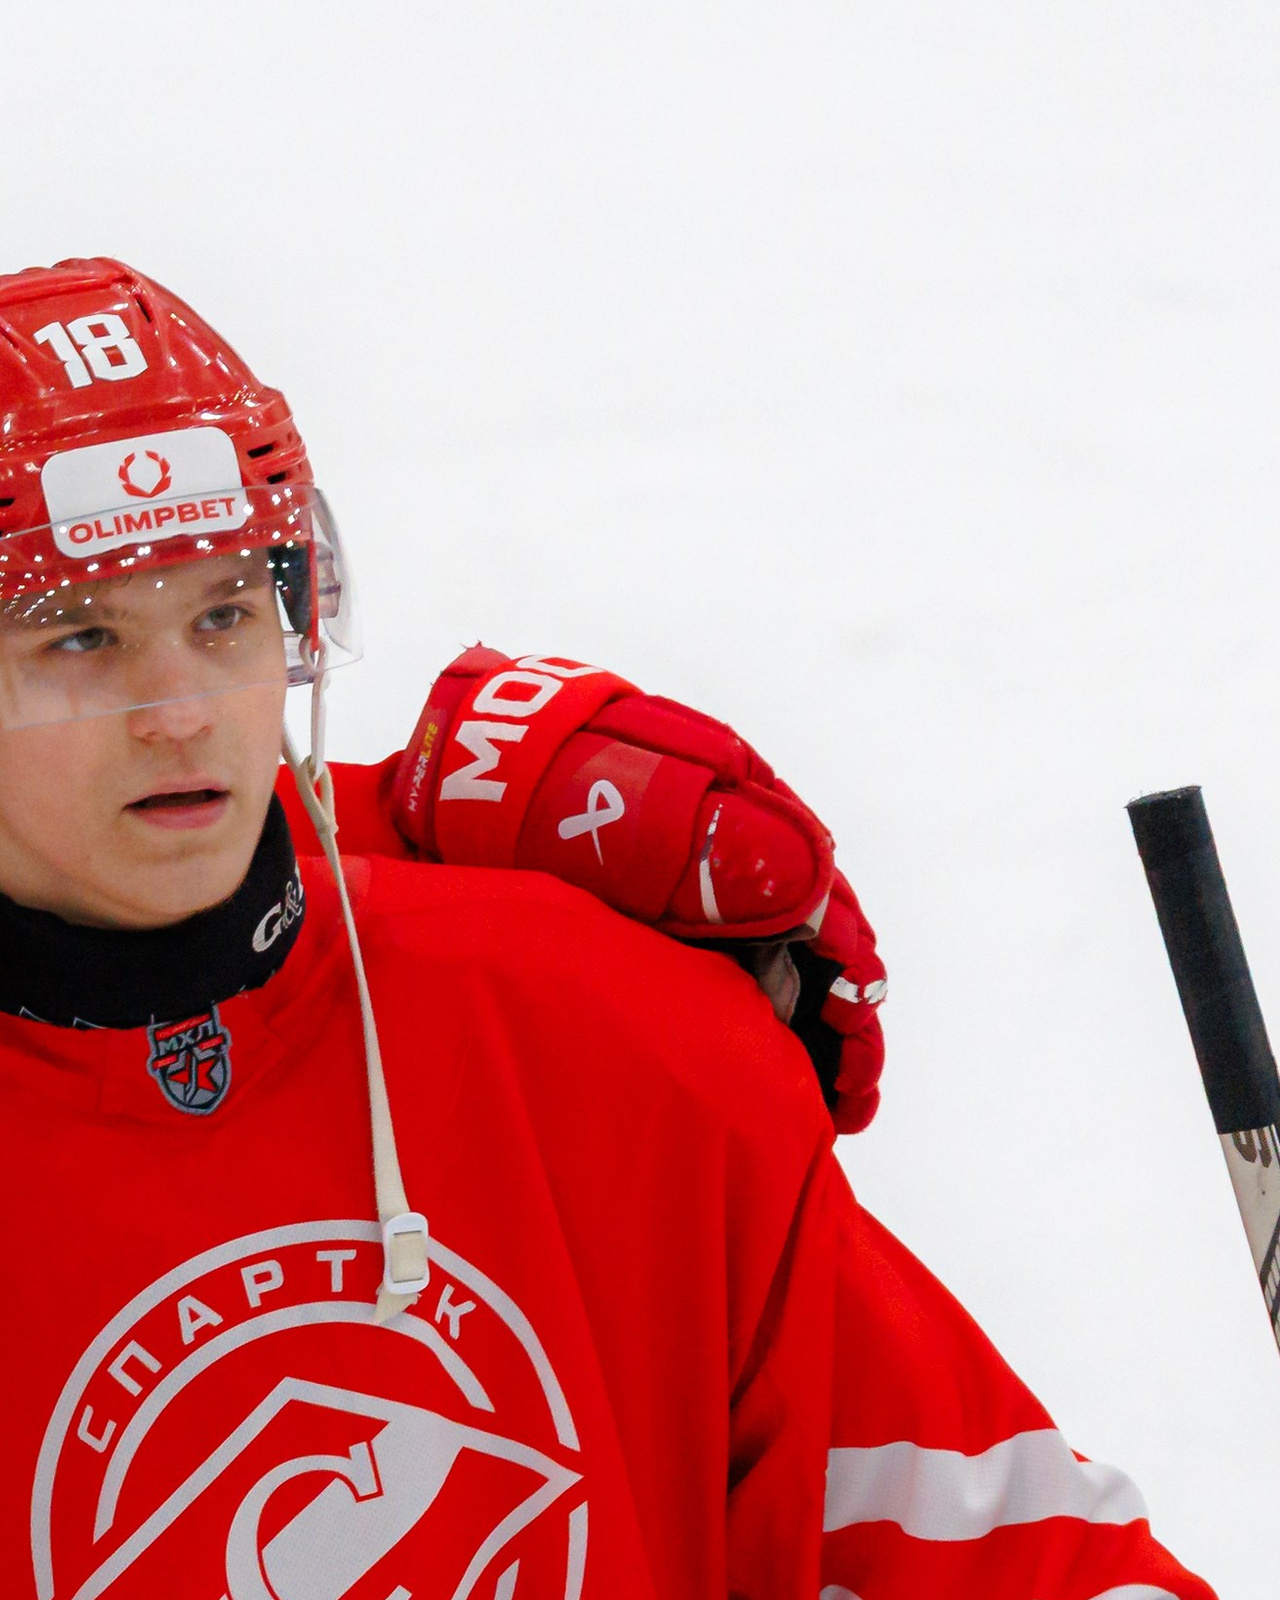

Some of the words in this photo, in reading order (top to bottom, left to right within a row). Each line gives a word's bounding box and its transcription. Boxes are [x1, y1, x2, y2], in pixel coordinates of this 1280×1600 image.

[32, 313, 149, 389] 18
[68, 496, 237, 545] OLIMPBET
[76, 1248, 477, 1455] СПАРТК
